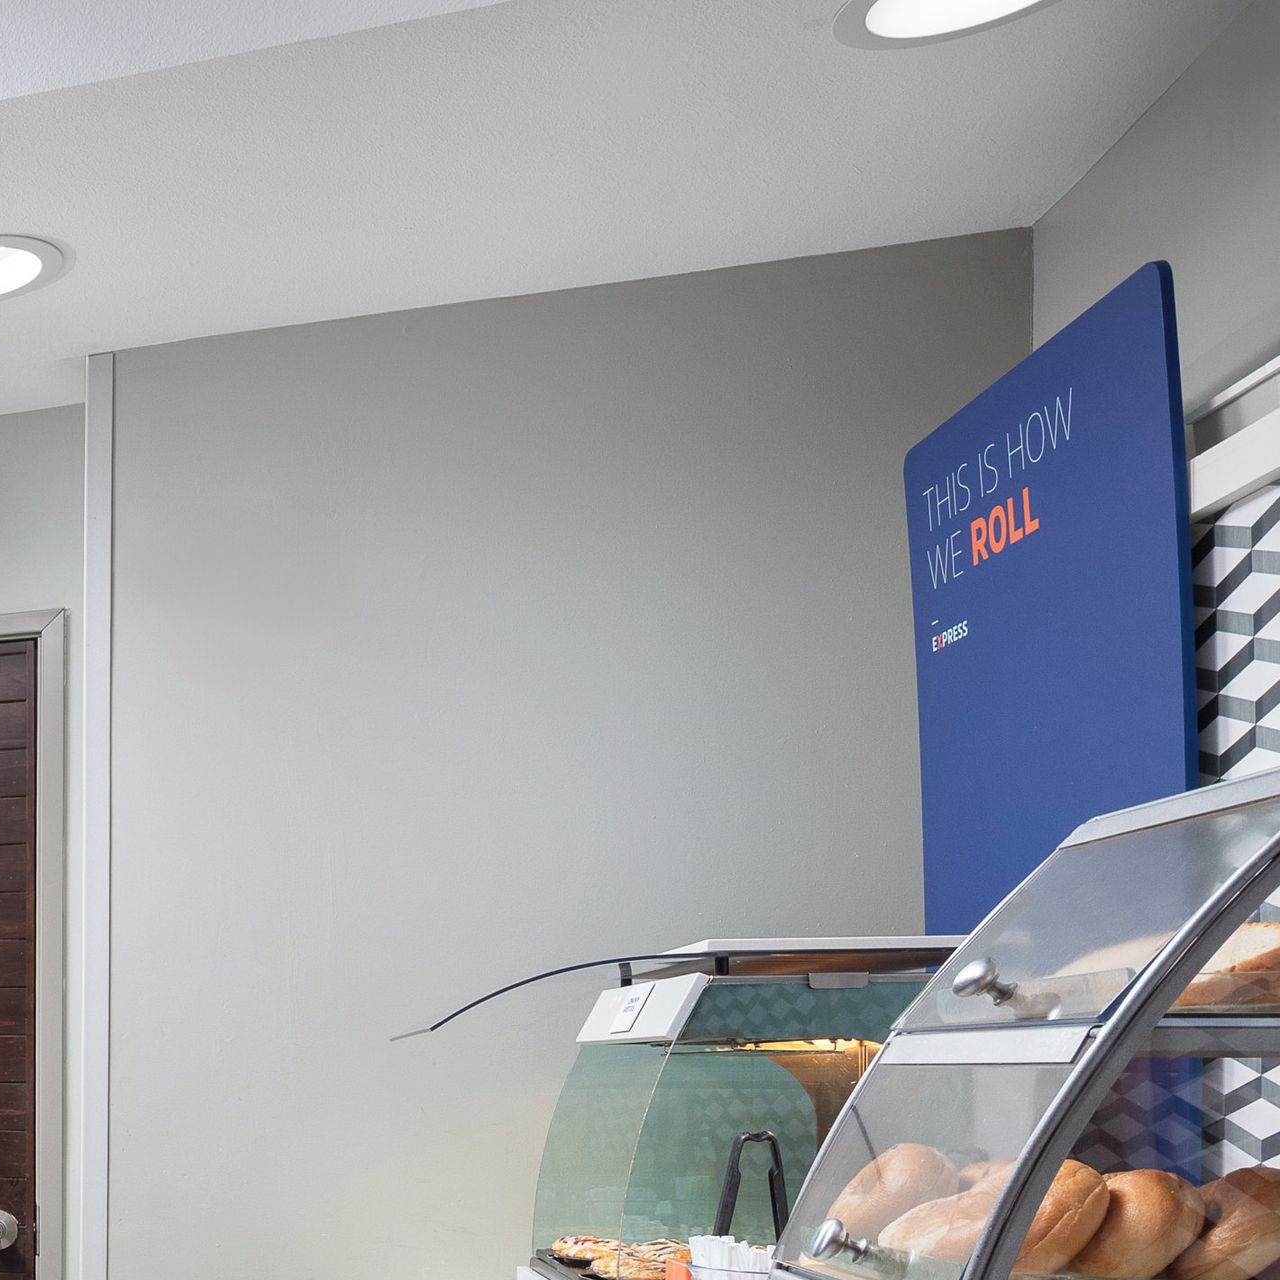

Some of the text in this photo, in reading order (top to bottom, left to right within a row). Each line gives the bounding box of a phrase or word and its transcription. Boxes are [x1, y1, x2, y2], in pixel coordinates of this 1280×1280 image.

[923, 387, 1072, 532] THIS IS HOW
[927, 487, 1040, 590] WE ROLL
[932, 620, 968, 652] EXPRESS
